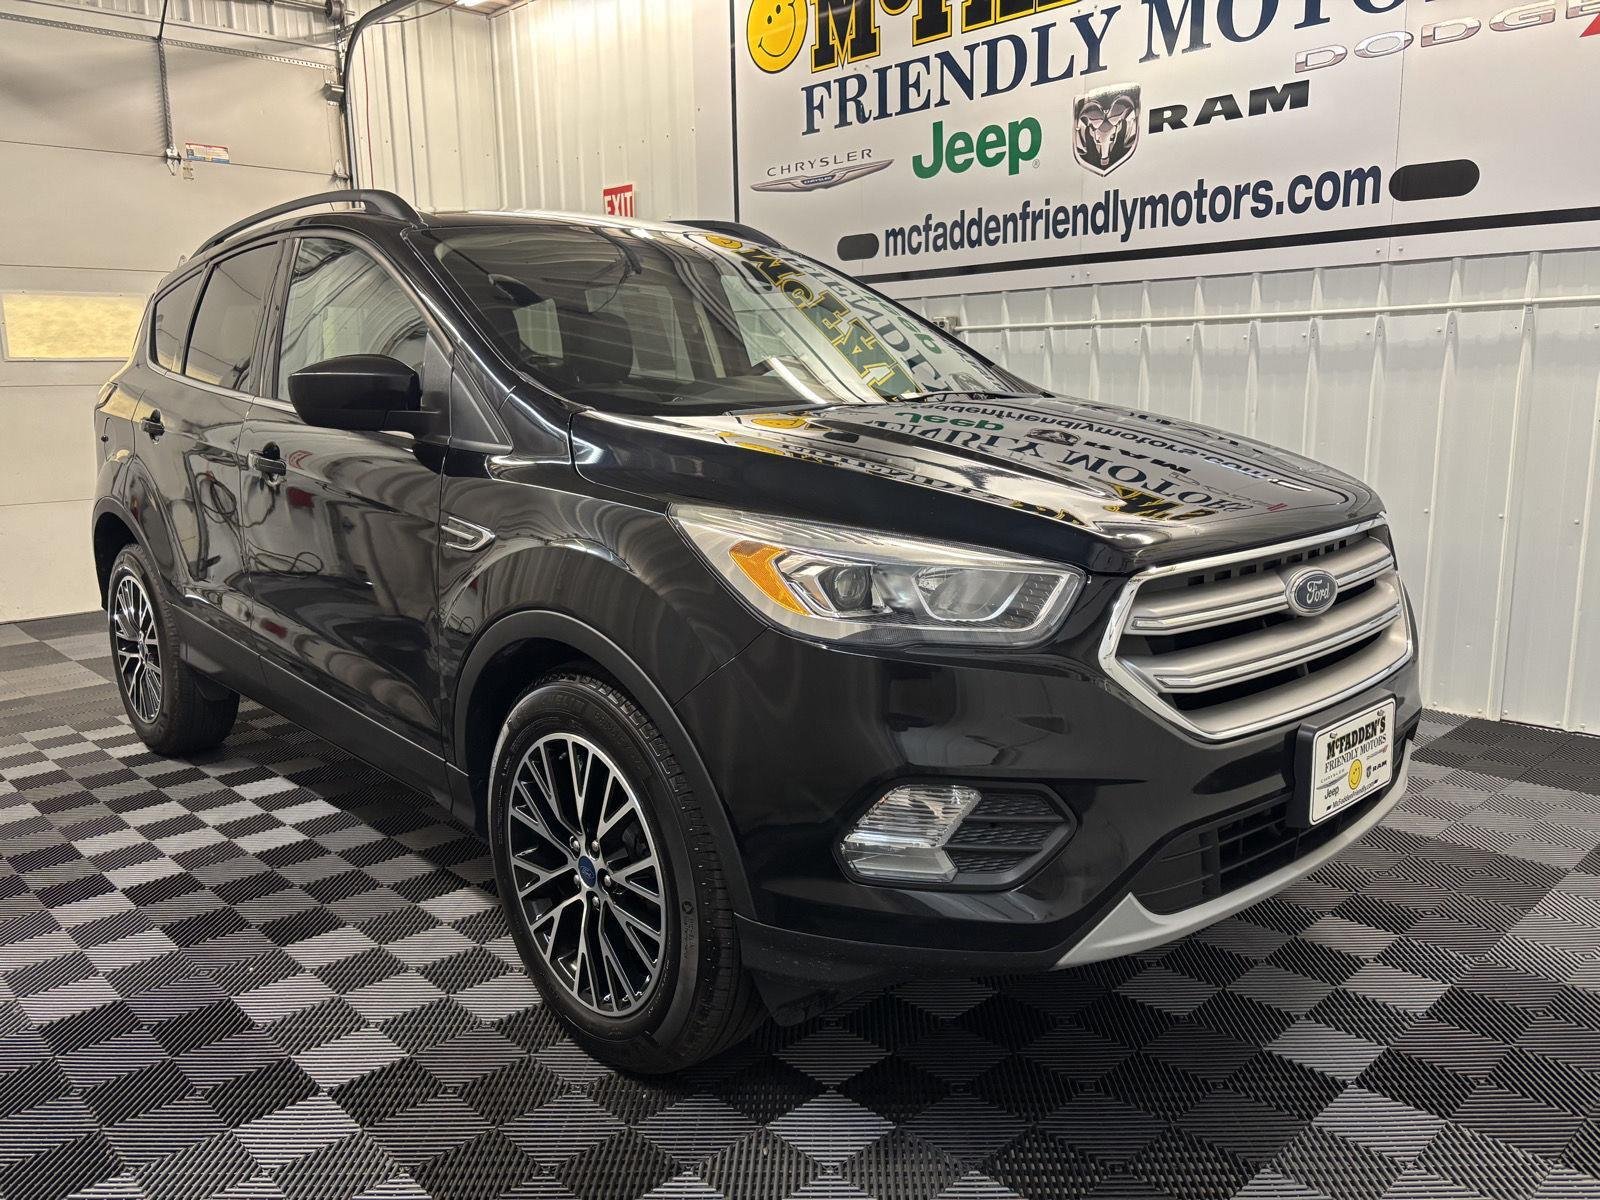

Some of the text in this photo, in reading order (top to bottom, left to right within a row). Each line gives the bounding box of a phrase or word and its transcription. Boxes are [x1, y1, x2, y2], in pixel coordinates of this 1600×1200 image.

[801, 5, 1121, 137] FRIENDLY
[1148, 79, 1311, 134] RAM
[766, 148, 873, 177] CHRYSLER
[912, 116, 1043, 179] Jeep
[604, 192, 633, 217] EXIT
[884, 164, 1382, 258] mcfaddenfriendlymotors.com
[1306, 580, 1330, 604] Ford
[1325, 746, 1359, 773] FRIENDLY
[1360, 733, 1386, 756] MOTORS
[1324, 786, 1339, 800] Jeep
